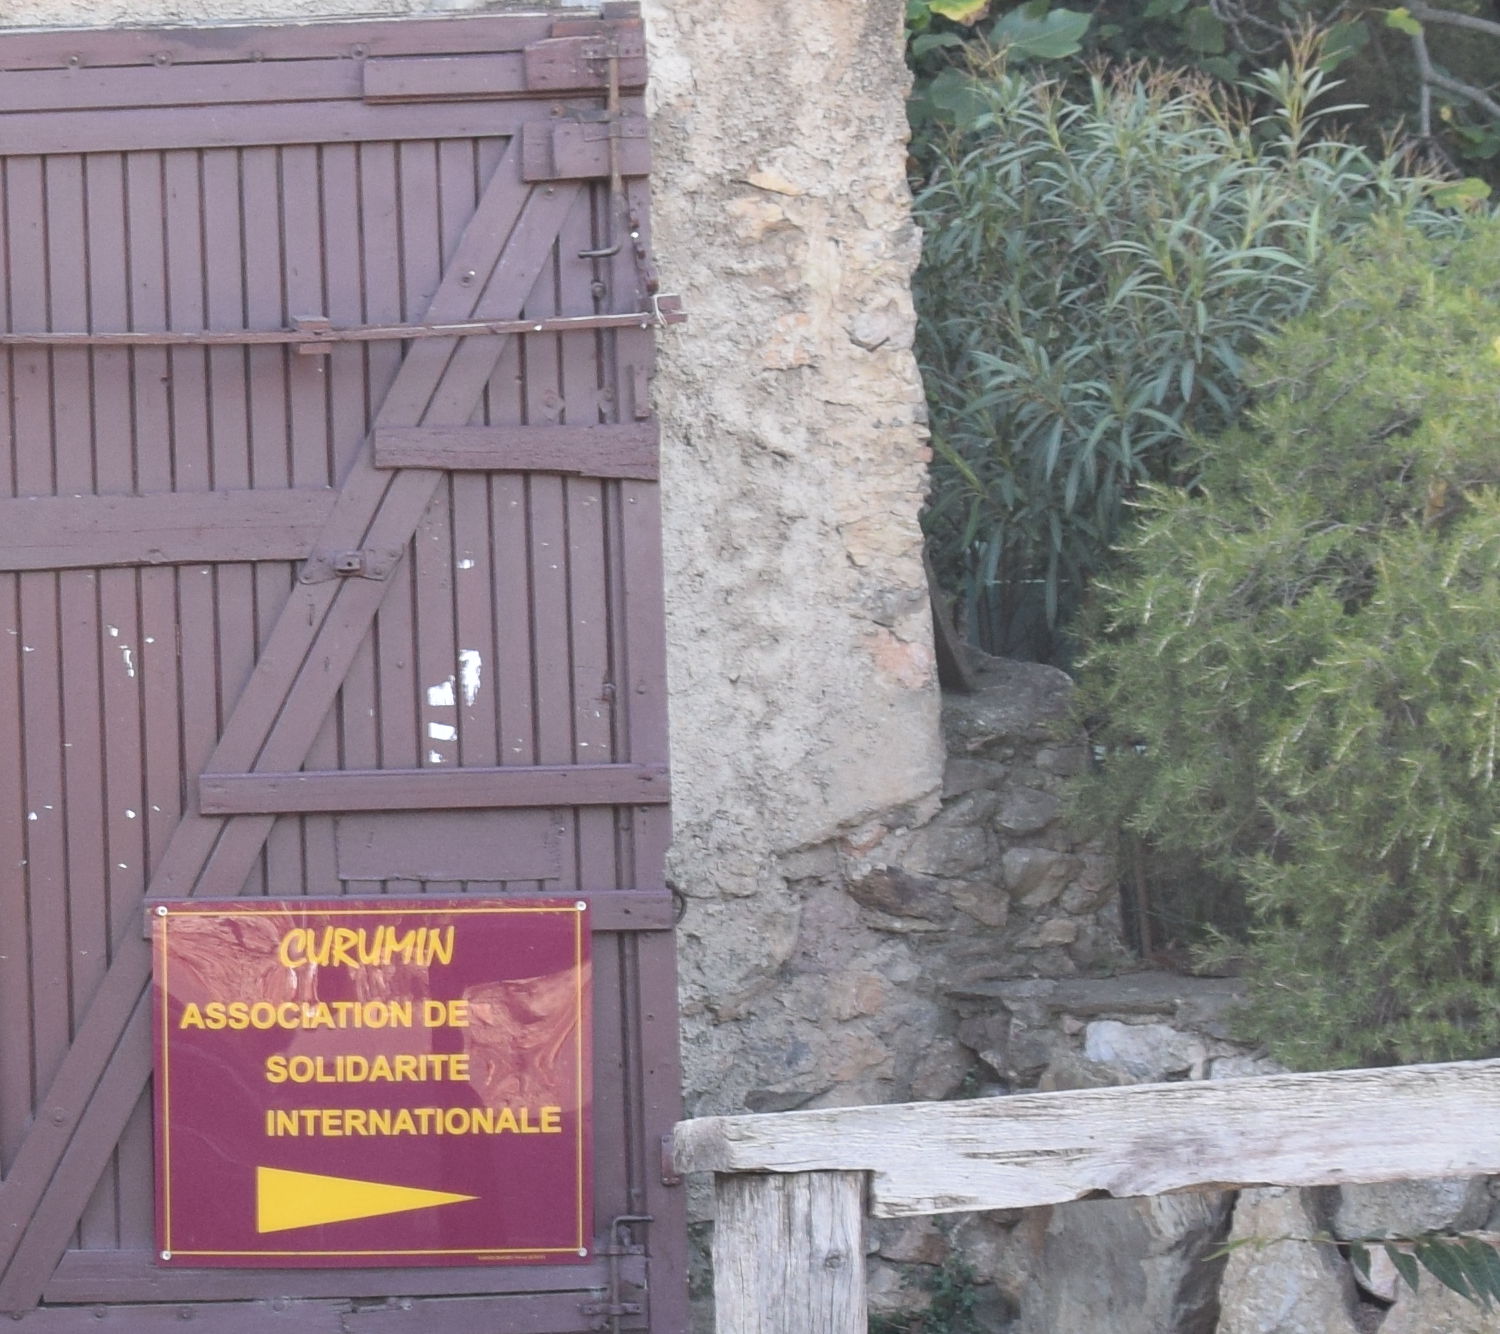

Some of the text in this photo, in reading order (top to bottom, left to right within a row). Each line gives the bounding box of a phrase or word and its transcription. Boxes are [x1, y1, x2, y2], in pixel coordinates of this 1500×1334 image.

[278, 925, 456, 969] CURUMIN
[179, 1000, 469, 1031] ASSOCIATION DE
[265, 1053, 470, 1084] SOLIDARITE
[266, 1105, 562, 1138] INTERNATIONALE
